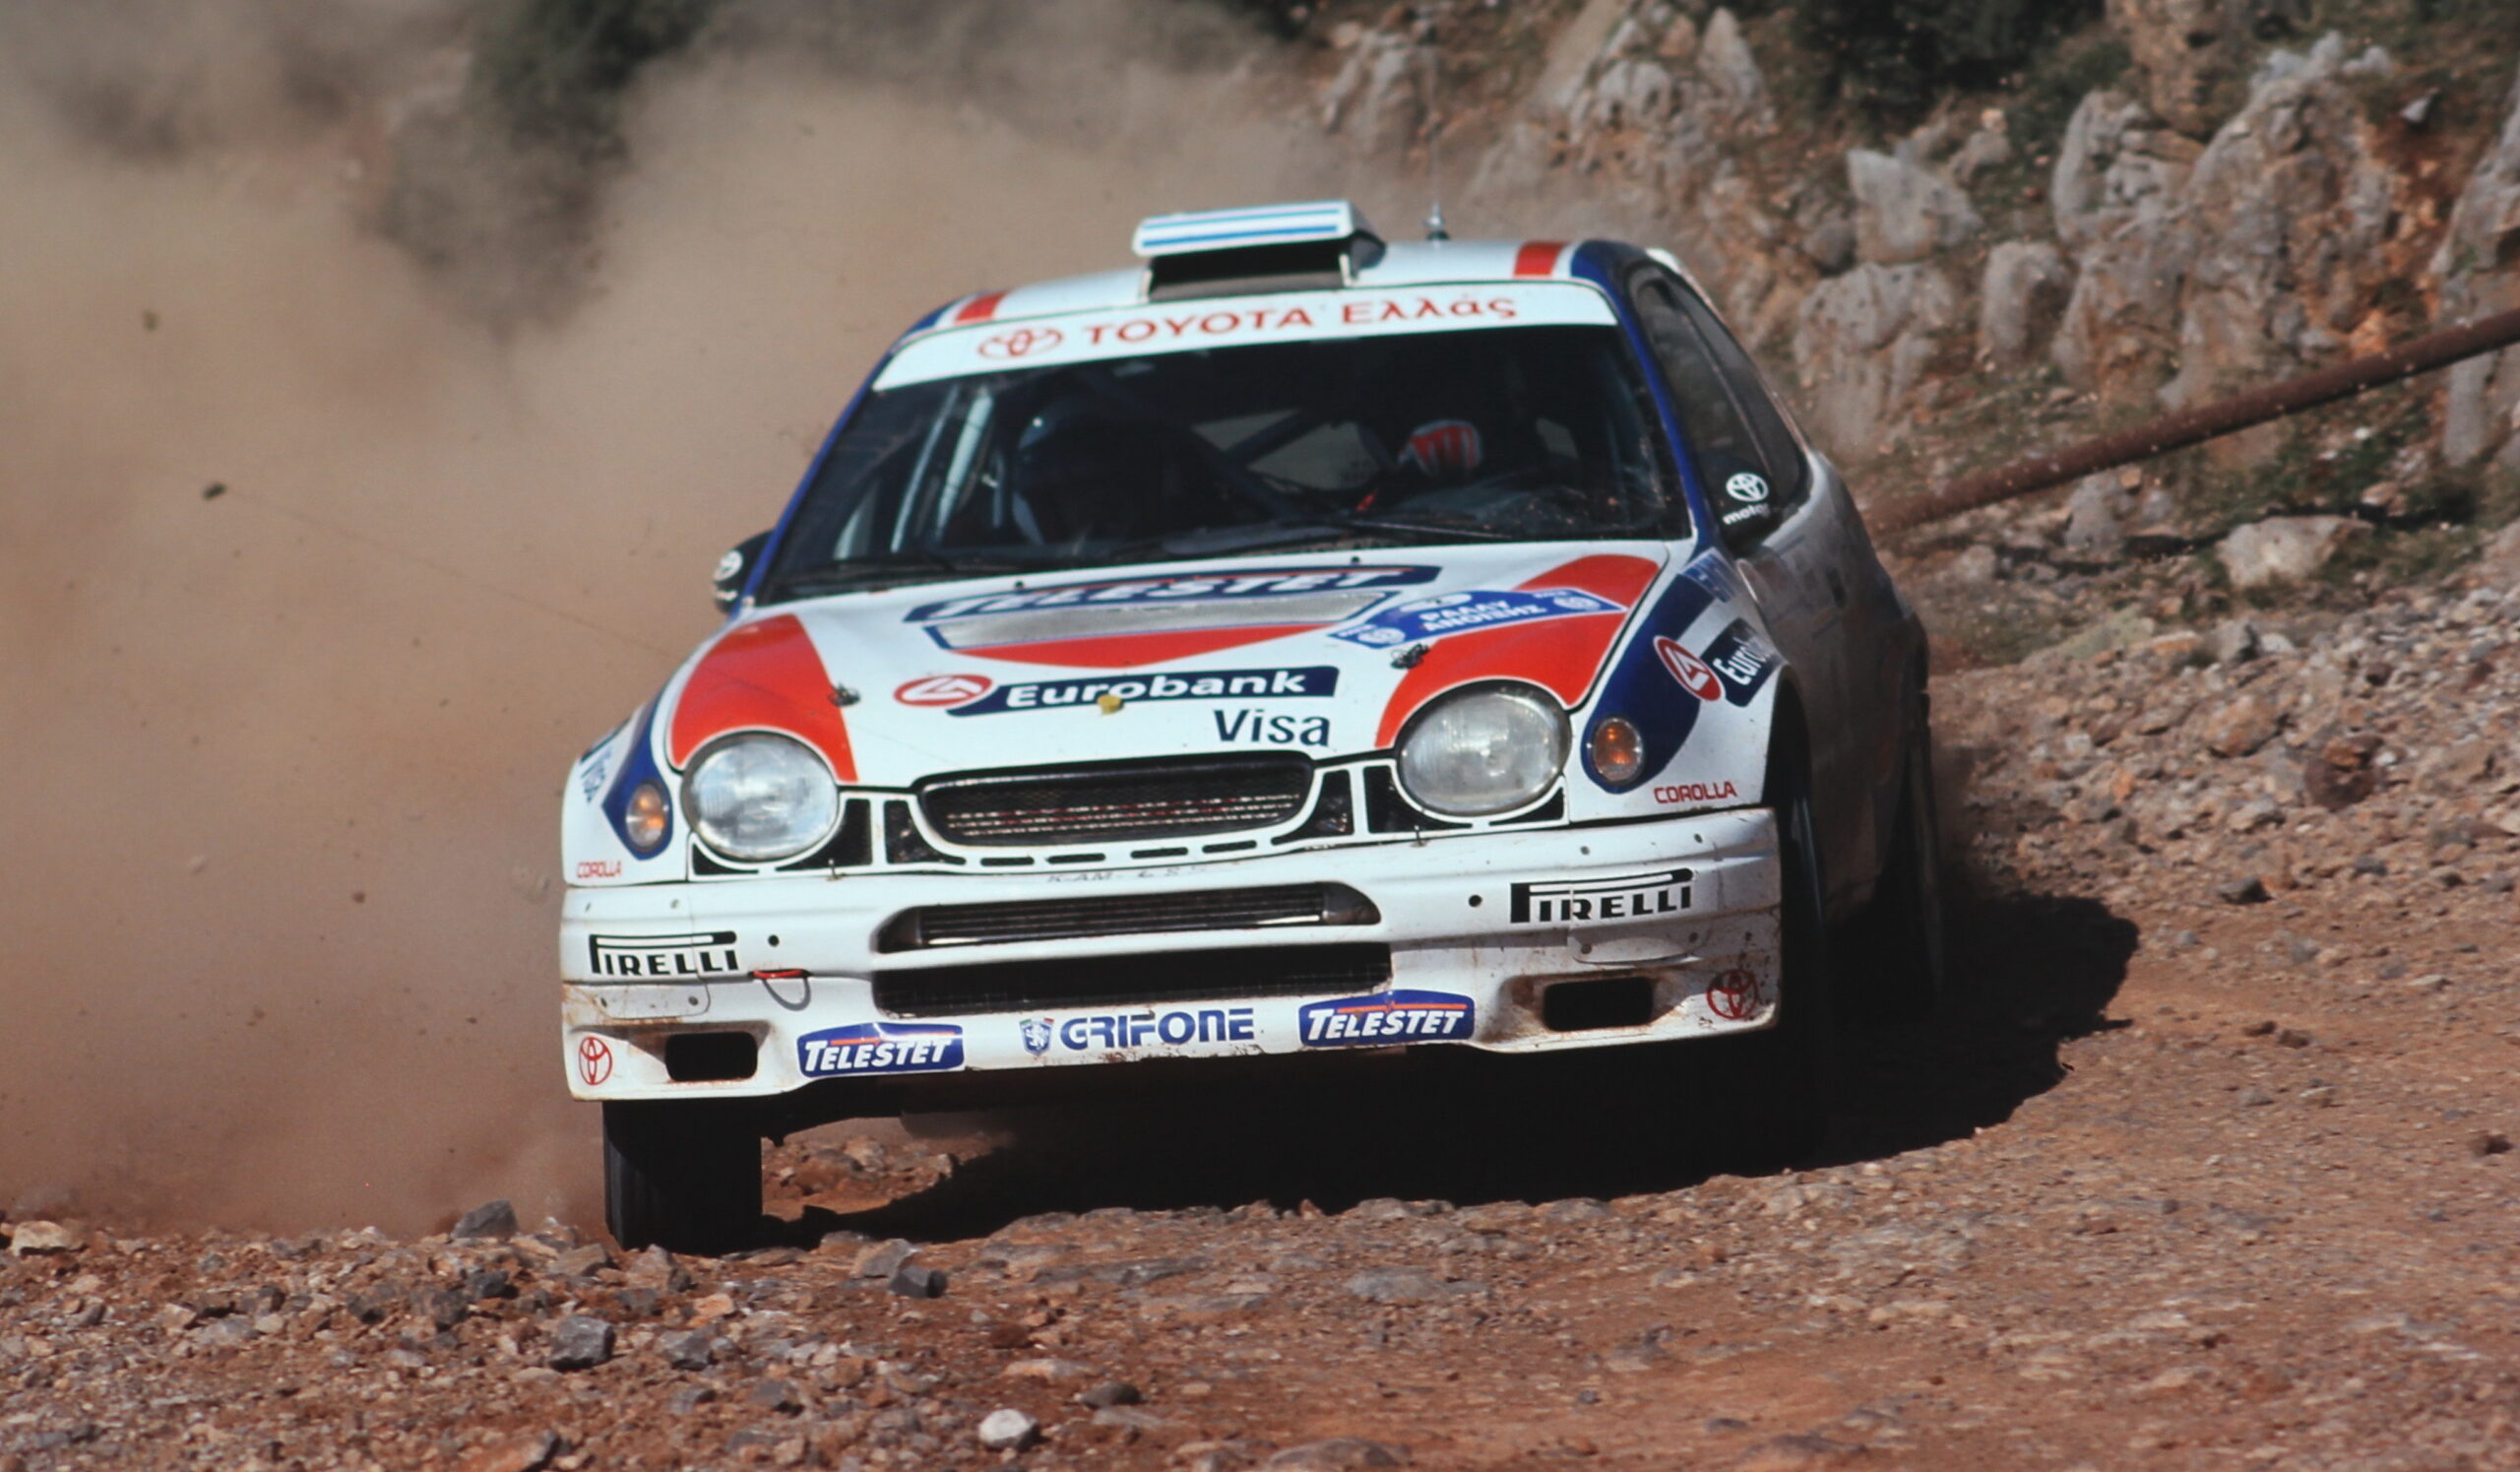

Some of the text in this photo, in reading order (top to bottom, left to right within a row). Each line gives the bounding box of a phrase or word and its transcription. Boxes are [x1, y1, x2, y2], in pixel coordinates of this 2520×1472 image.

[1084, 307, 1313, 345] TOYOTA
[1006, 671, 1306, 708] Eurobank
[1213, 709, 1331, 746] Visa
[1654, 781, 1737, 803] COROLLA
[1510, 867, 1694, 924] PIRELLI
[589, 930, 739, 976] PIRELLI
[1060, 1007, 1255, 1051] GRIFONE
[1307, 1008, 1465, 1041] TELESTET
[804, 1039, 953, 1071] TELESTET
